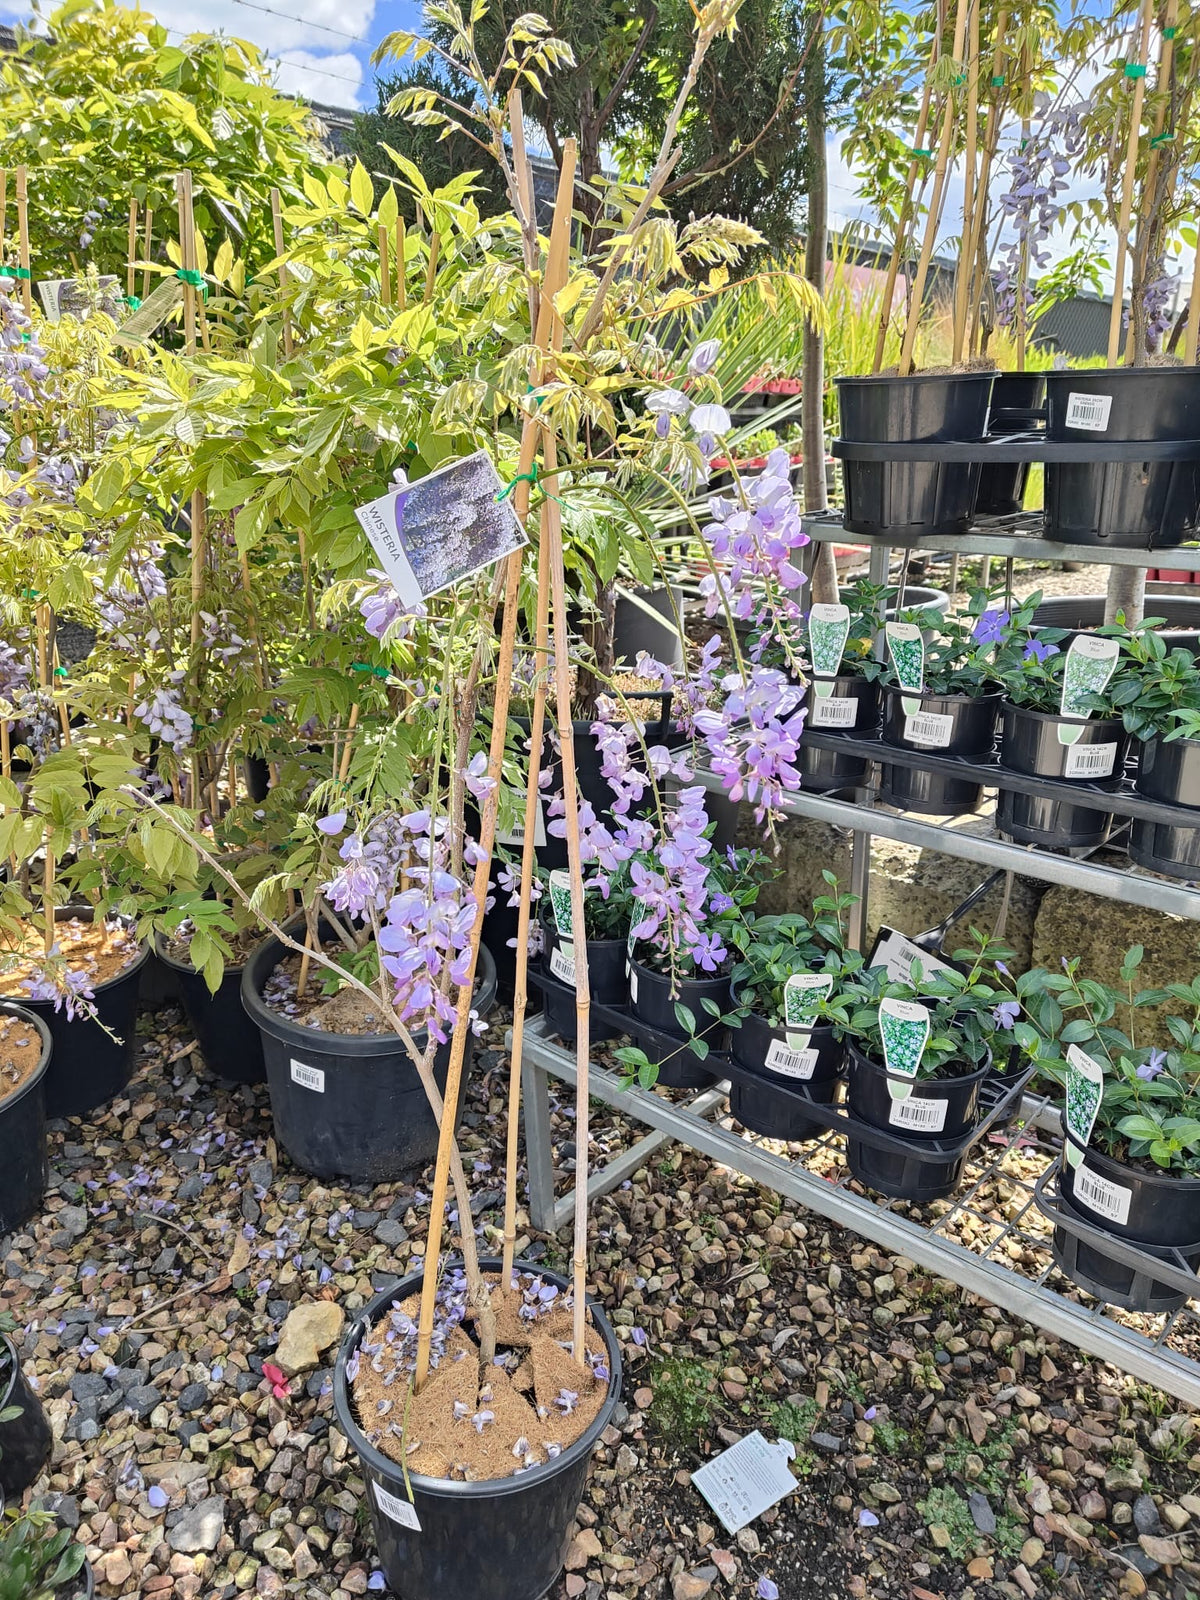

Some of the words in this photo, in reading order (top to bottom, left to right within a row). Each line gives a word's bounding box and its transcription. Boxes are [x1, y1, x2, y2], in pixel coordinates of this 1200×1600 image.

[360, 511, 379, 542] Chinese
[369, 506, 401, 562] WISTERIA
[896, 1003, 913, 1011] VINCA
[1080, 1055, 1092, 1068] VINCA
